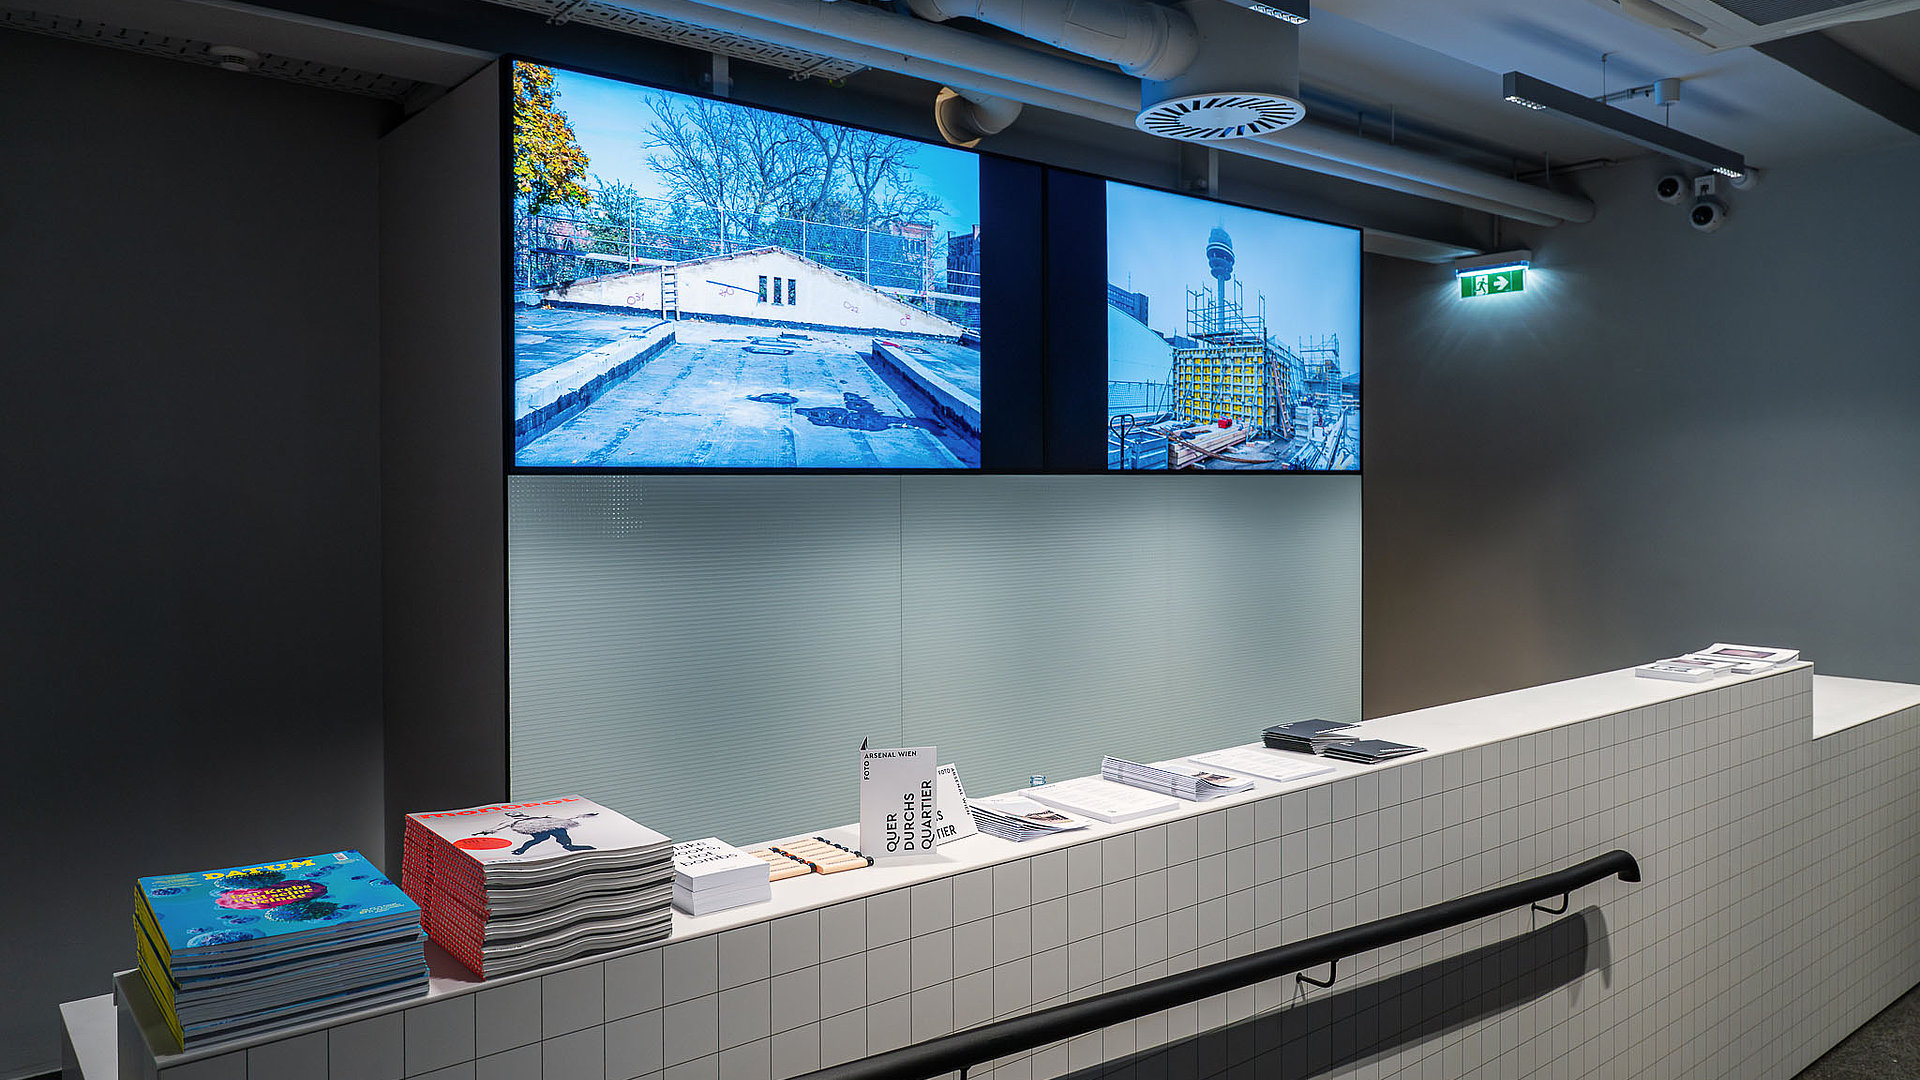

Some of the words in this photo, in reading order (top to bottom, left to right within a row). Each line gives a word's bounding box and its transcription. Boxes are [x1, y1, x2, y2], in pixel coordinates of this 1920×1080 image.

[886, 813, 901, 852] QUER
[904, 792, 915, 851] DURCHS
[921, 780, 935, 850] QUARTIER
[936, 824, 957, 839] TIER
[202, 859, 316, 881] DATUM
